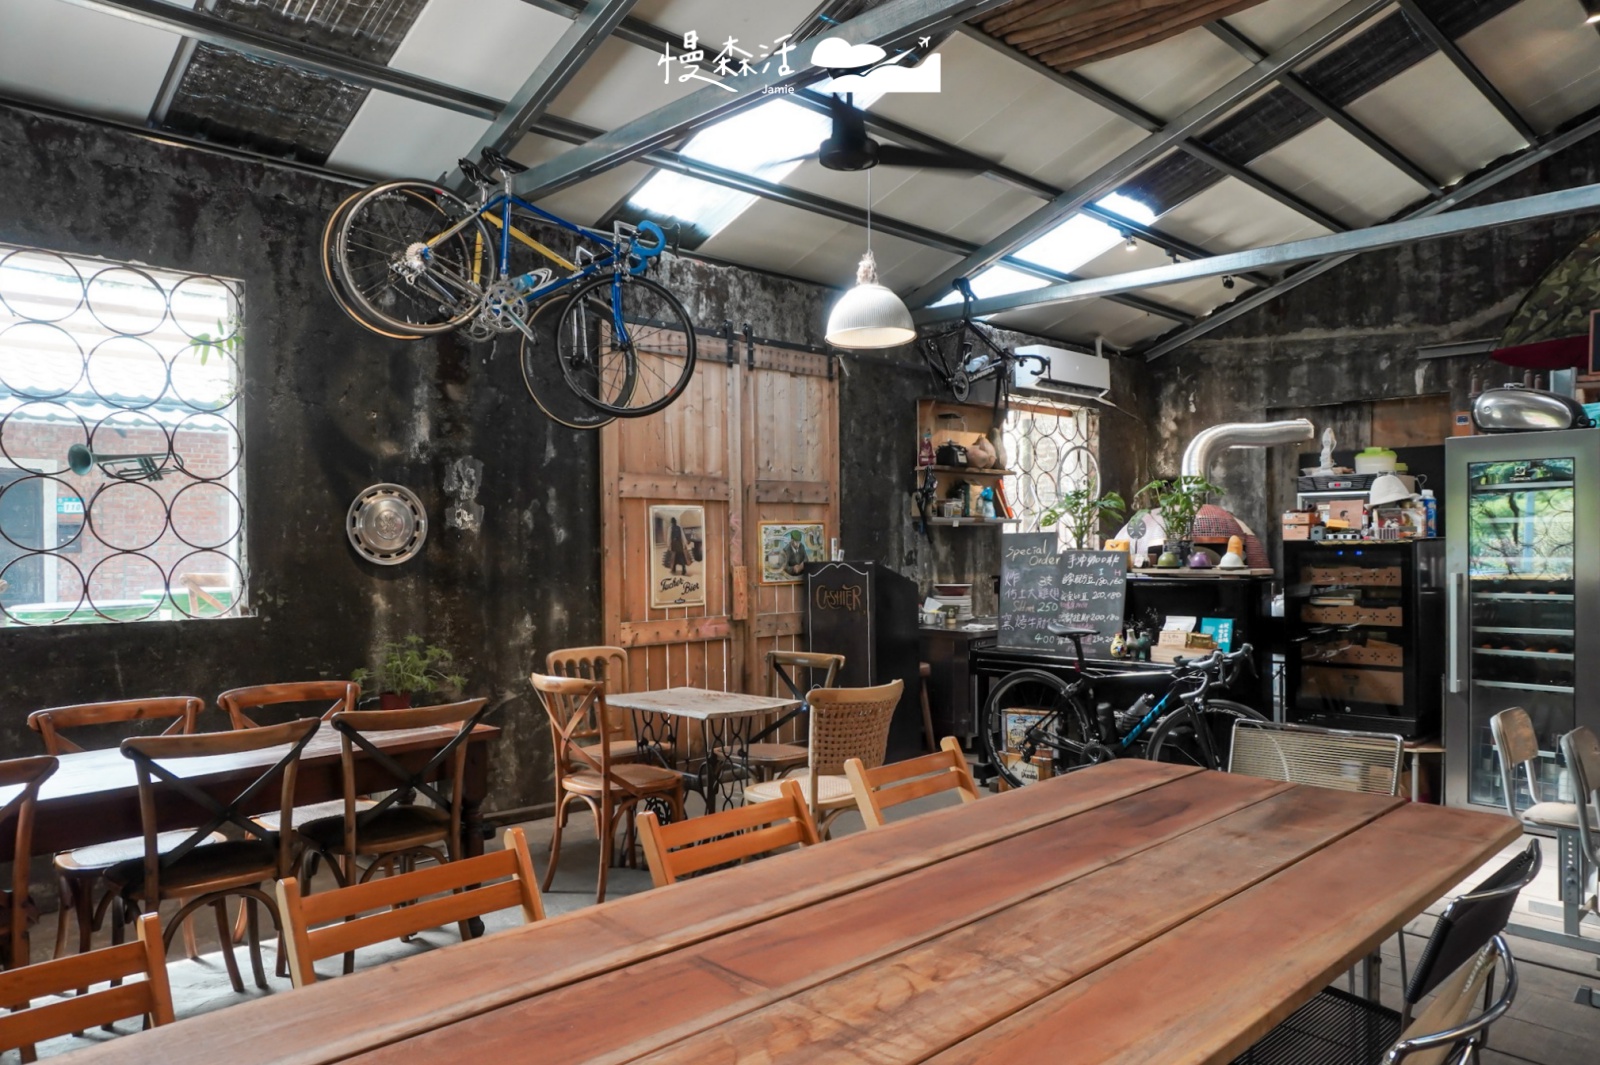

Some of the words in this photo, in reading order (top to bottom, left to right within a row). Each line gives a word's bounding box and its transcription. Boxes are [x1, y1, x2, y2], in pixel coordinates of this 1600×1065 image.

[1005, 539, 1047, 562] Special
[1028, 551, 1062, 566] Order
[681, 581, 700, 595] Bier
[816, 584, 862, 611] CASHIER
[1036, 601, 1059, 613] 250
[1034, 633, 1055, 644] 400
